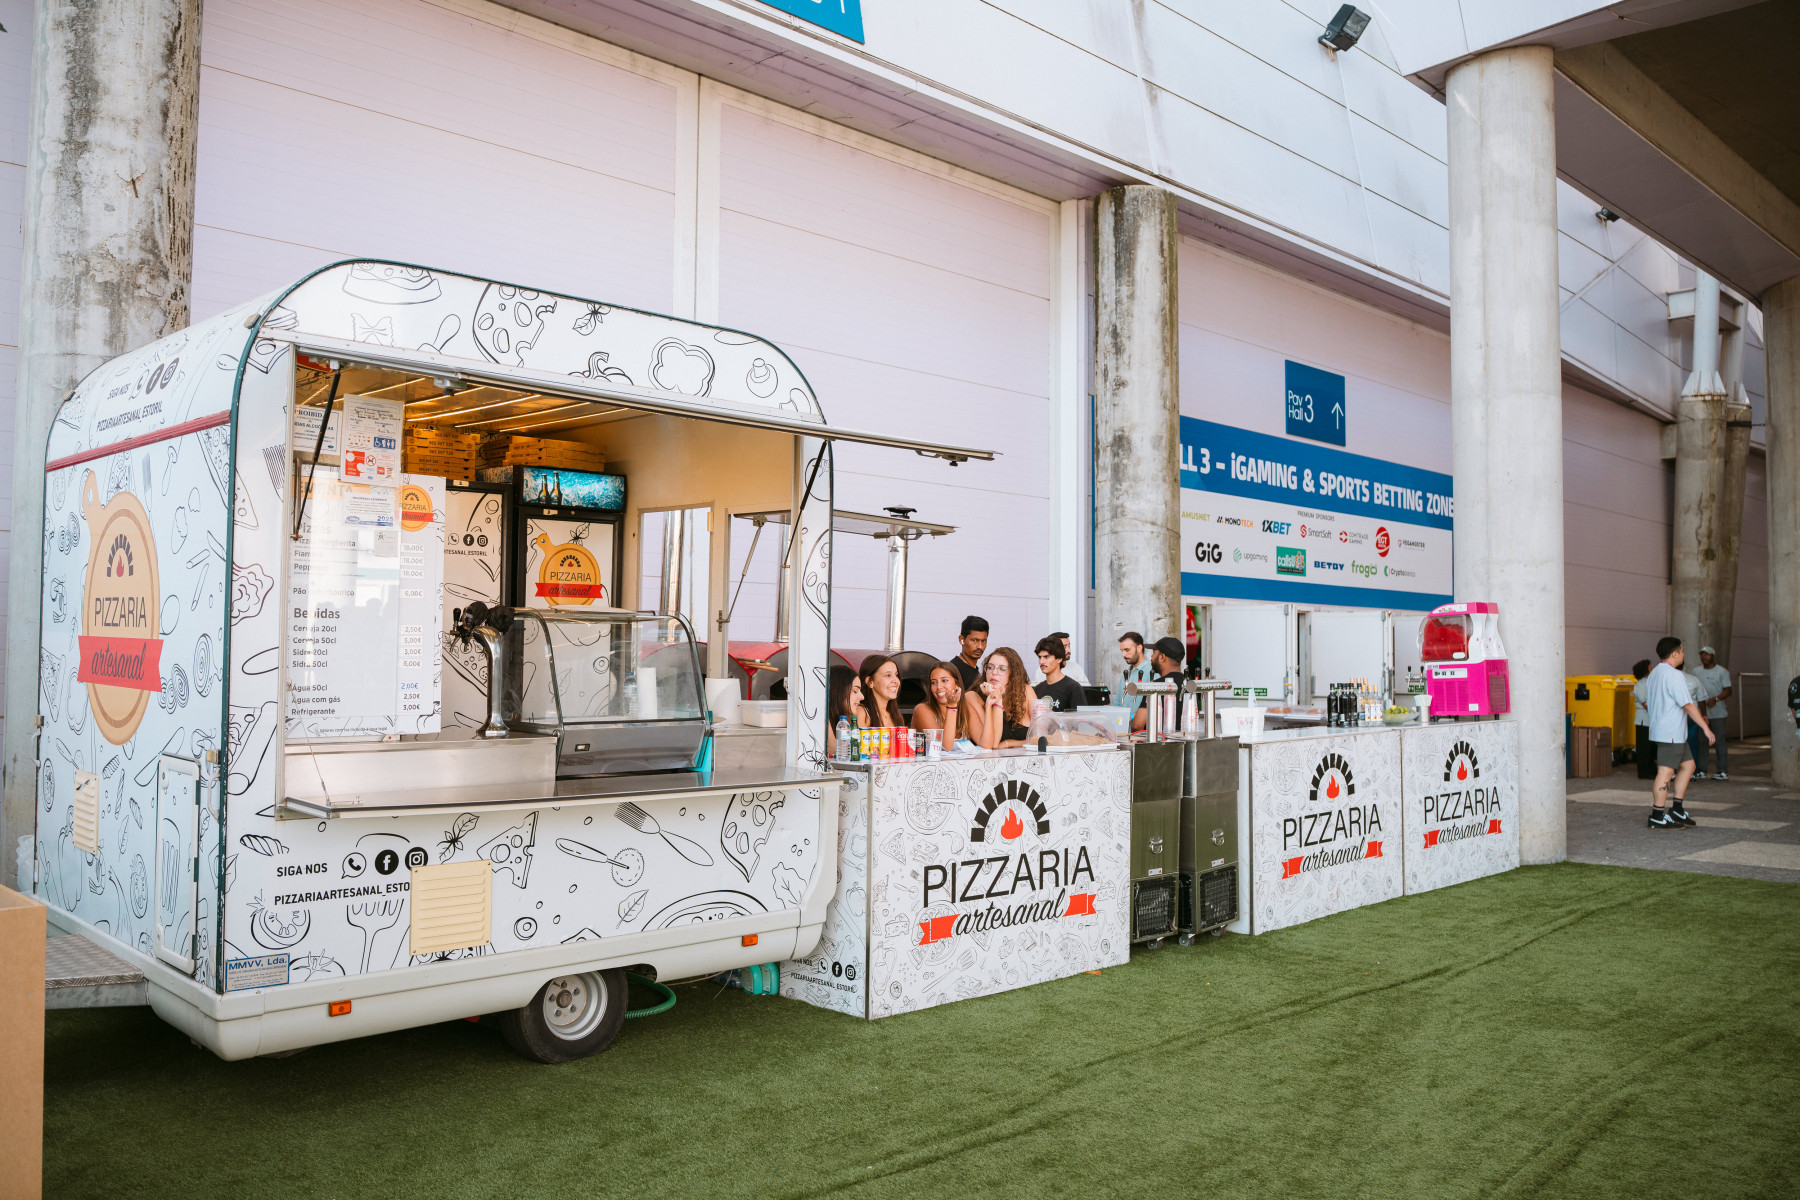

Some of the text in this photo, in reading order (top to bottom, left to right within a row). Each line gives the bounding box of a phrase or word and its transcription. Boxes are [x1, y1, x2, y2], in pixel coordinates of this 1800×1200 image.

[1288, 390, 1303, 406] Pav
[294, 408, 323, 418] PROIBID
[1288, 405, 1304, 421] Hall
[1304, 394, 1314, 423] 3
[1200, 448, 1211, 474] 3
[1231, 452, 1298, 490] iGAMING
[1303, 468, 1315, 493] &
[1319, 471, 1370, 503] SPORTS
[1374, 482, 1423, 512] BETTING
[1426, 492, 1454, 518] ZONE
[399, 503, 427, 511] IZZARIA
[1181, 511, 1211, 521] AMUSNET
[1225, 517, 1254, 528] MONOTECH
[1297, 510, 1335, 522] PREMIUM SPONSORS
[1262, 520, 1292, 535] 1XBET
[1308, 528, 1332, 539] SmartSoft
[1195, 541, 1222, 564] GiG
[1243, 551, 1268, 563] upgaming
[550, 571, 592, 582] PIZZARIA
[548, 586, 591, 596] artesanal
[94, 597, 147, 628] PIZZARIA
[294, 608, 340, 619] Beidas
[92, 642, 147, 680] artesanal
[292, 684, 311, 692] Água
[292, 708, 336, 716] Refrigerante
[1424, 786, 1501, 824] PIZZARIA
[1283, 803, 1382, 851] PIZZARIA
[1438, 815, 1488, 844] artesanal
[1302, 837, 1366, 873] artesanal
[277, 863, 328, 877] SIGA NOS
[923, 845, 1095, 908] PIZZARIA
[956, 888, 1066, 936] artesanal
[229, 957, 287, 971] MMVV, Lda.
